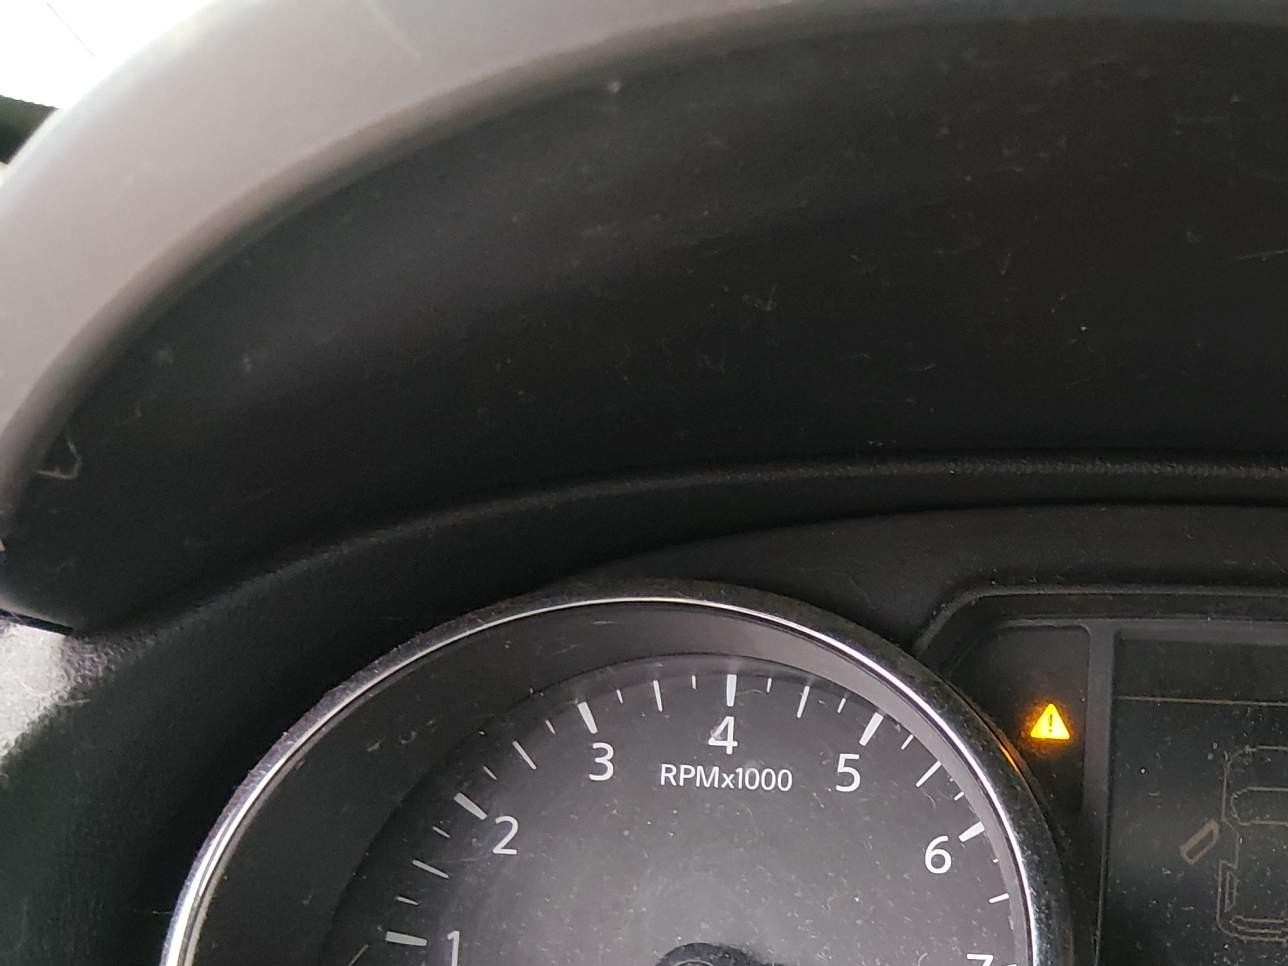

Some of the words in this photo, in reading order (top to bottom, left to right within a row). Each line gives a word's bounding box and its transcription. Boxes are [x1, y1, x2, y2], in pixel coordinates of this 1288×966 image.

[707, 715, 738, 755] 4
[588, 742, 614, 781] 3
[660, 763, 793, 792] RPMx1000
[835, 753, 861, 793] 5
[492, 815, 519, 855] 2
[924, 835, 952, 874] 6
